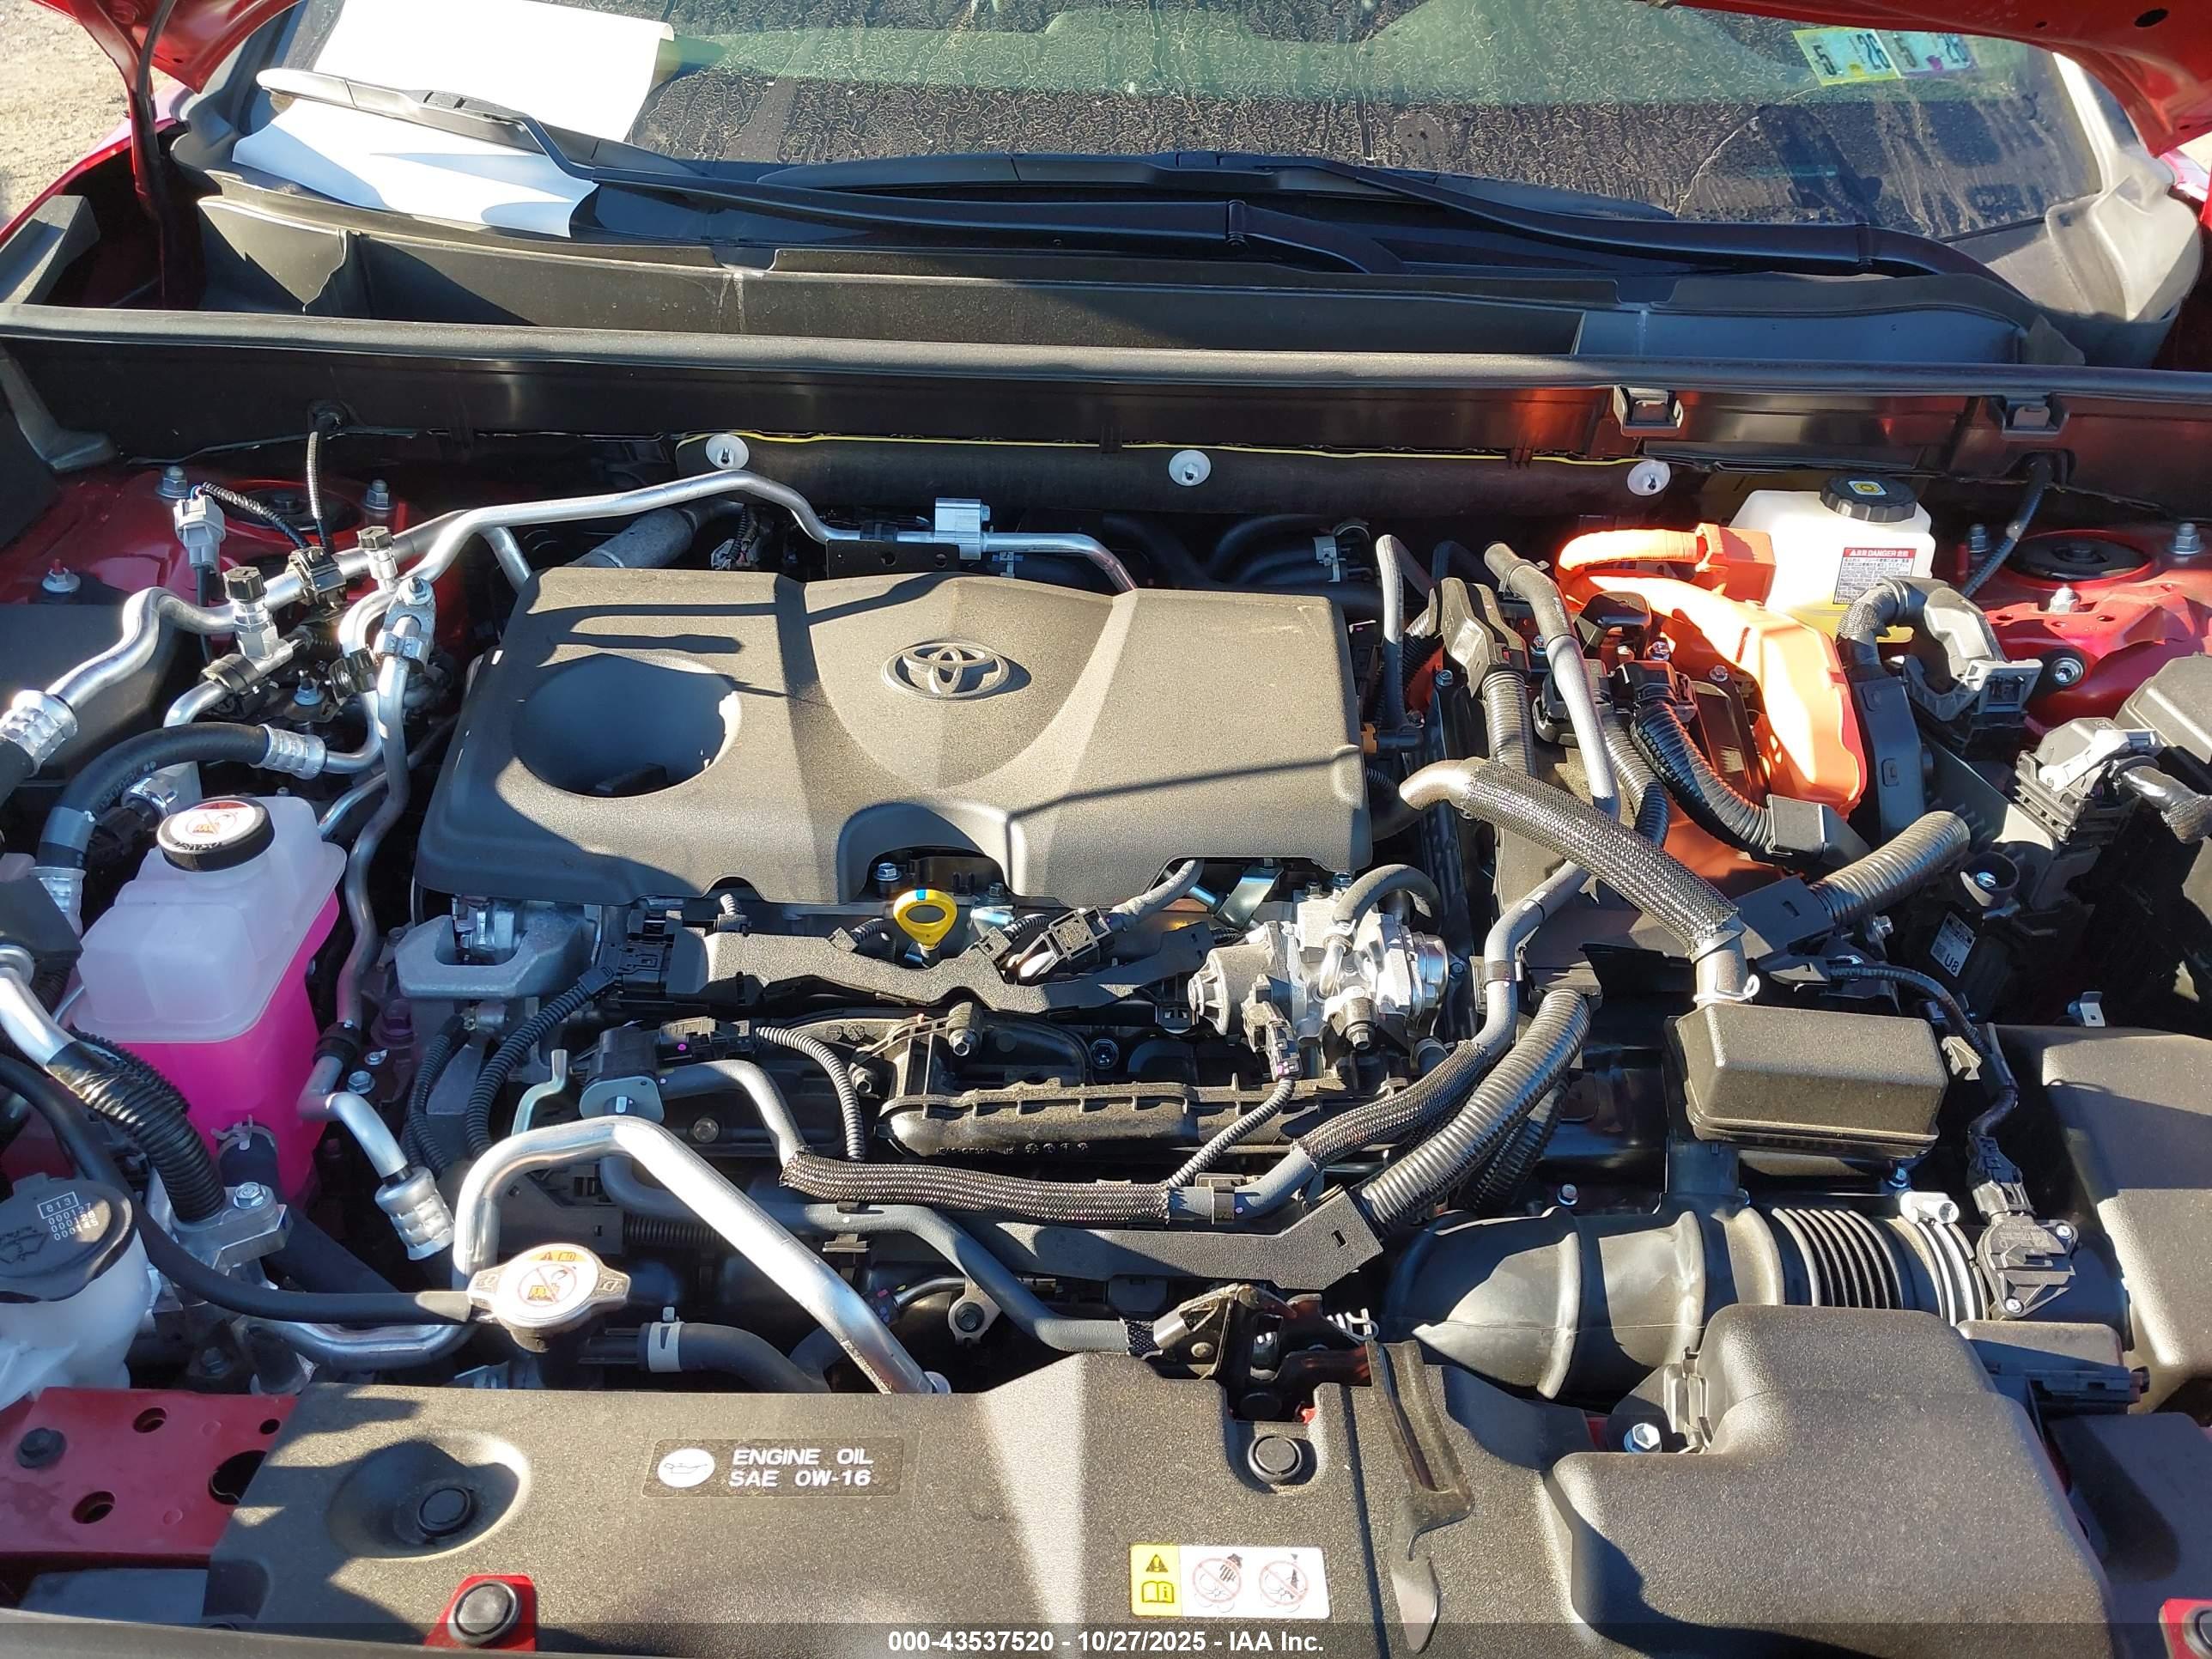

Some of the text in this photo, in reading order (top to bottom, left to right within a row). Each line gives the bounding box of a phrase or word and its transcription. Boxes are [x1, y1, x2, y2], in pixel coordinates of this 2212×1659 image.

[1856, 33, 1891, 70] 26
[1944, 953, 1960, 973] U8
[46, 1197, 72, 1212] e13
[48, 1202, 92, 1225] 000127
[51, 1210, 96, 1233] 000128
[732, 1449, 874, 1466] ENGINE OIL
[728, 1469, 872, 1487] SAE 0W-16
